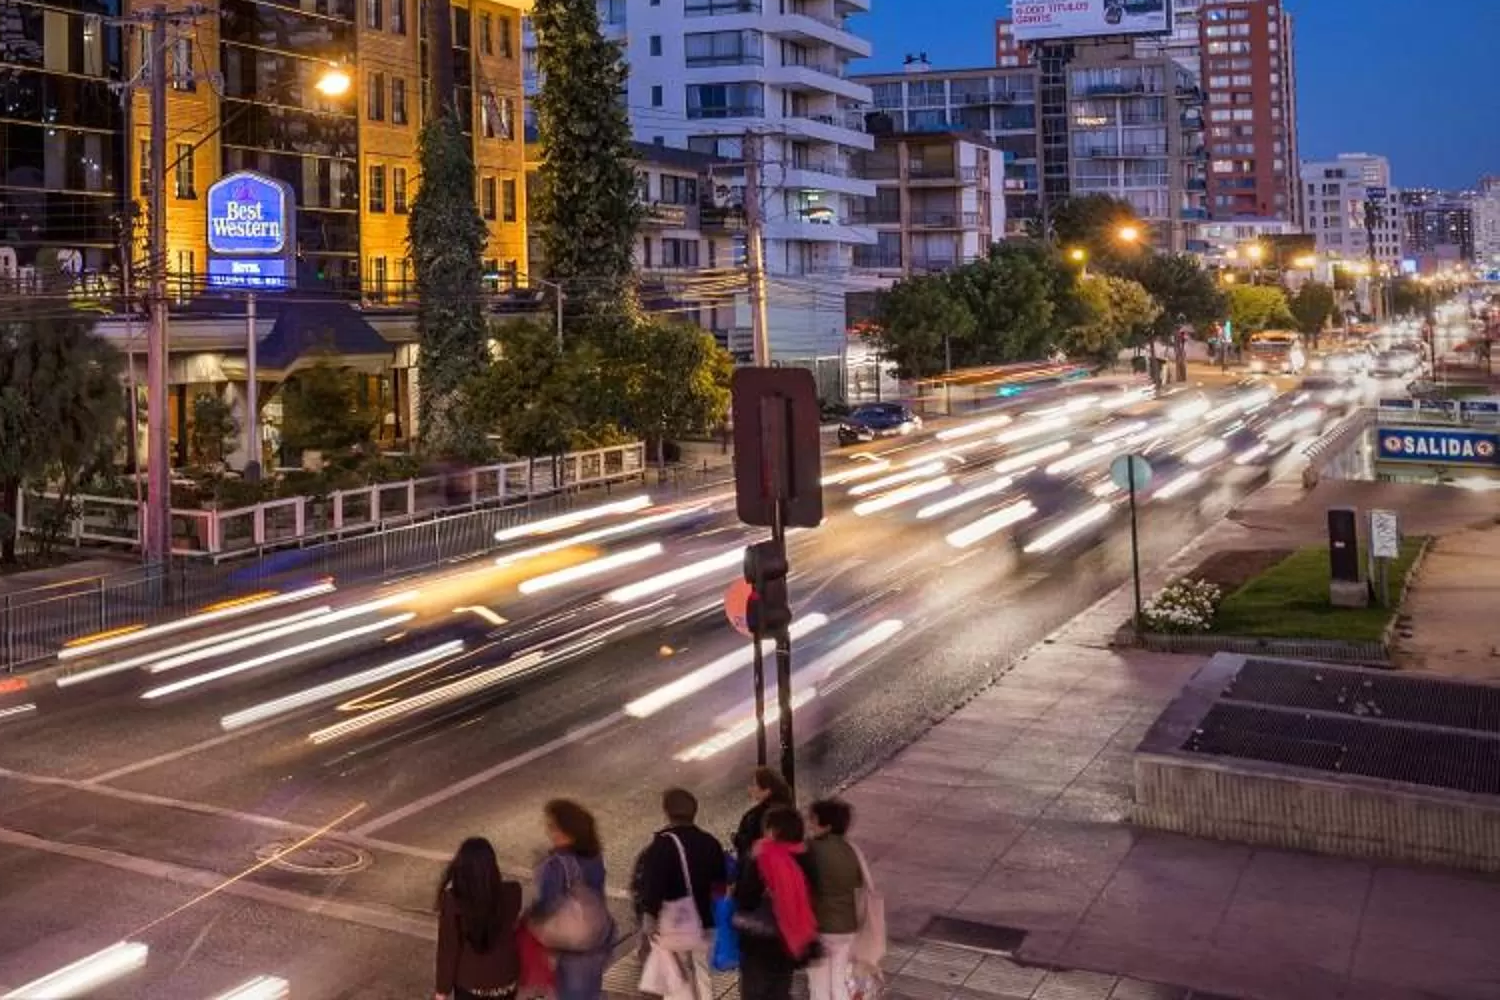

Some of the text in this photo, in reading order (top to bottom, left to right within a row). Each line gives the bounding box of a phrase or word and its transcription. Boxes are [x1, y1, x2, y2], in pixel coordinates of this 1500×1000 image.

[227, 200, 264, 221] Best
[213, 217, 281, 238] Western
[1403, 435, 1475, 457] SALIDA
